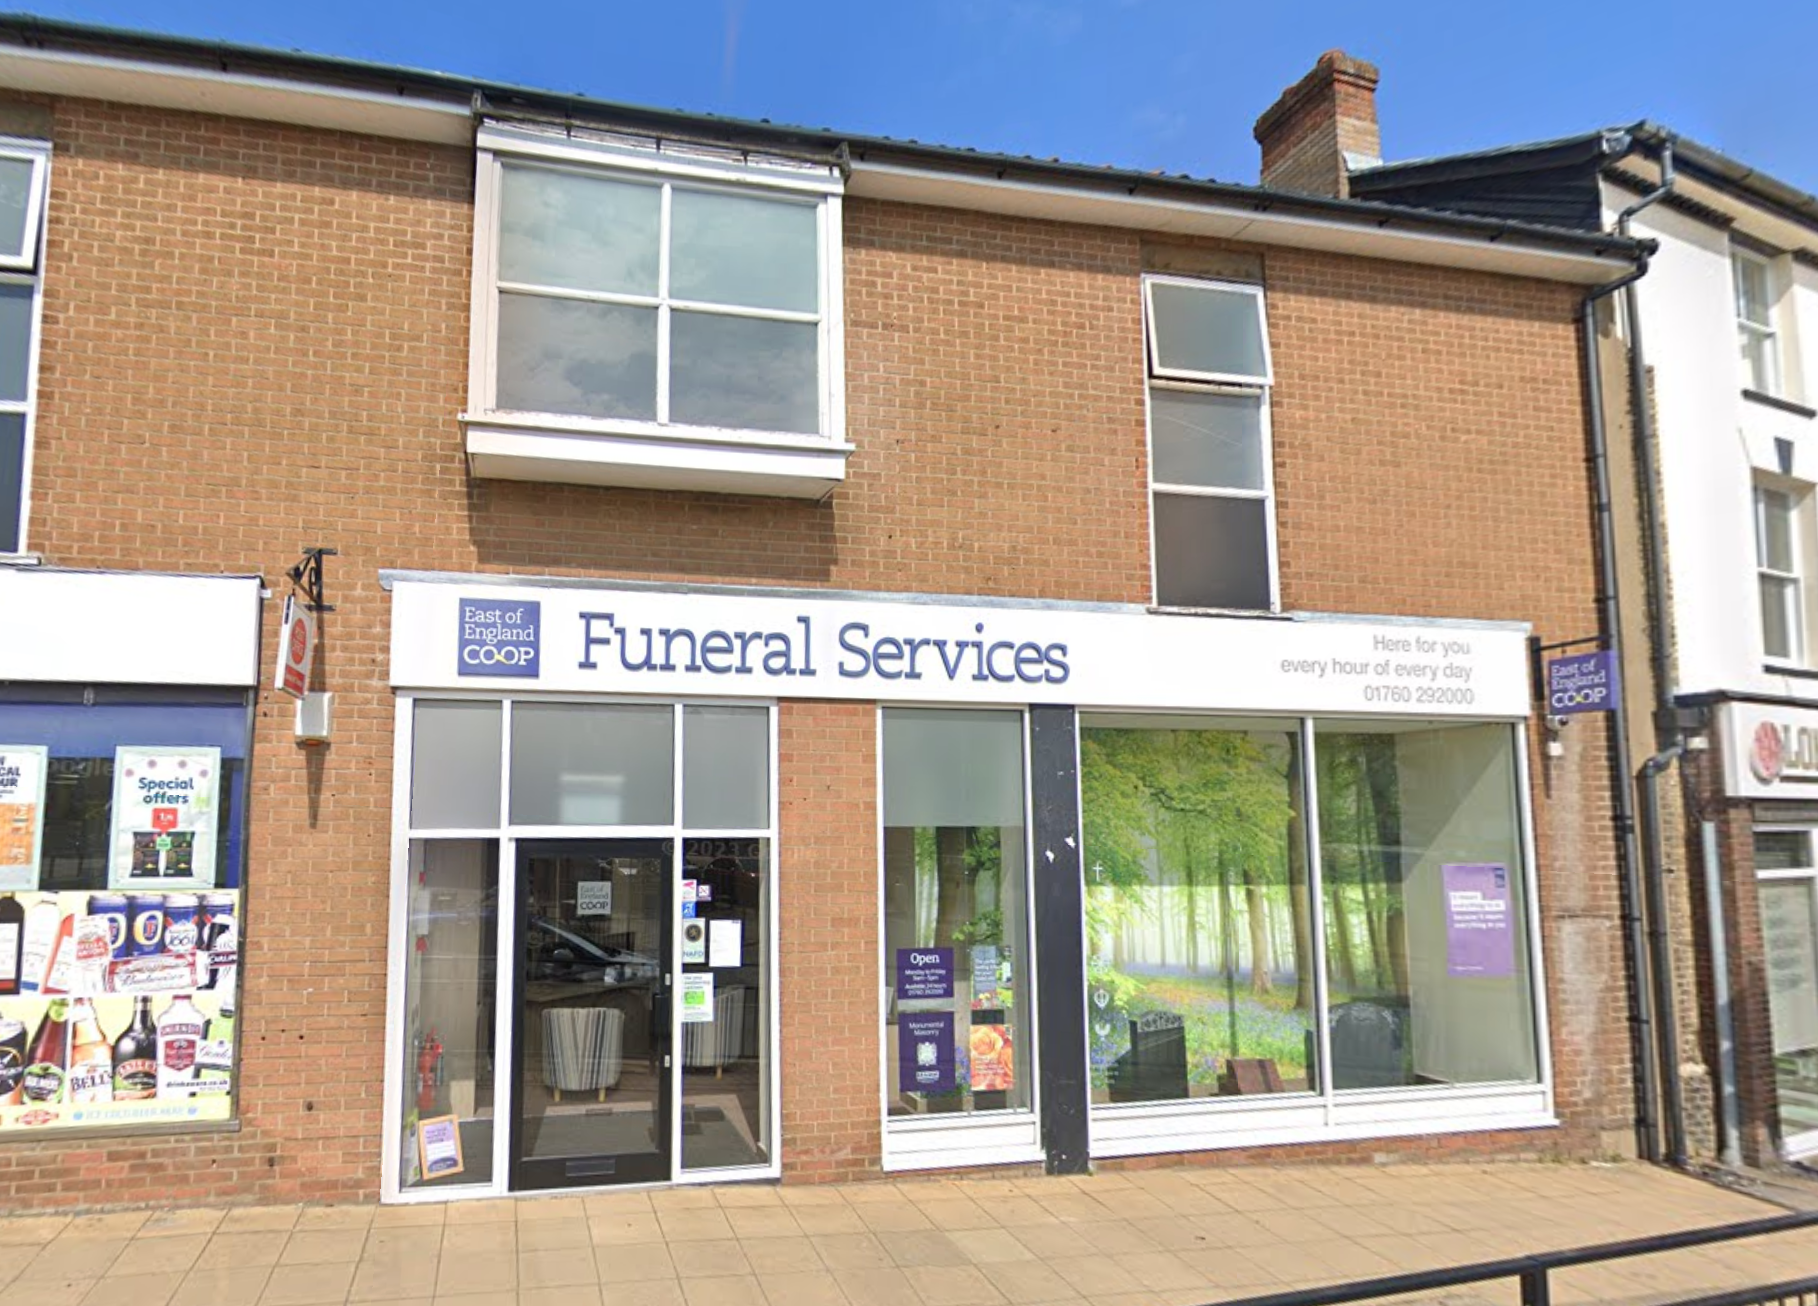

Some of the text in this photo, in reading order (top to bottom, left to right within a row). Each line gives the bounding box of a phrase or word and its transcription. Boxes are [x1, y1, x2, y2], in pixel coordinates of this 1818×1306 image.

[464, 607, 524, 624] East of
[464, 624, 535, 644] England
[578, 611, 1071, 684] Funeral Services
[1372, 634, 1470, 658] Here for you
[1281, 658, 1473, 684] every hour of every day
[1363, 684, 1475, 705] 01760 292000
[138, 777, 194, 793] Special
[142, 791, 190, 804] offers
[910, 953, 940, 966] Open
[908, 1021, 945, 1029] Monumental
